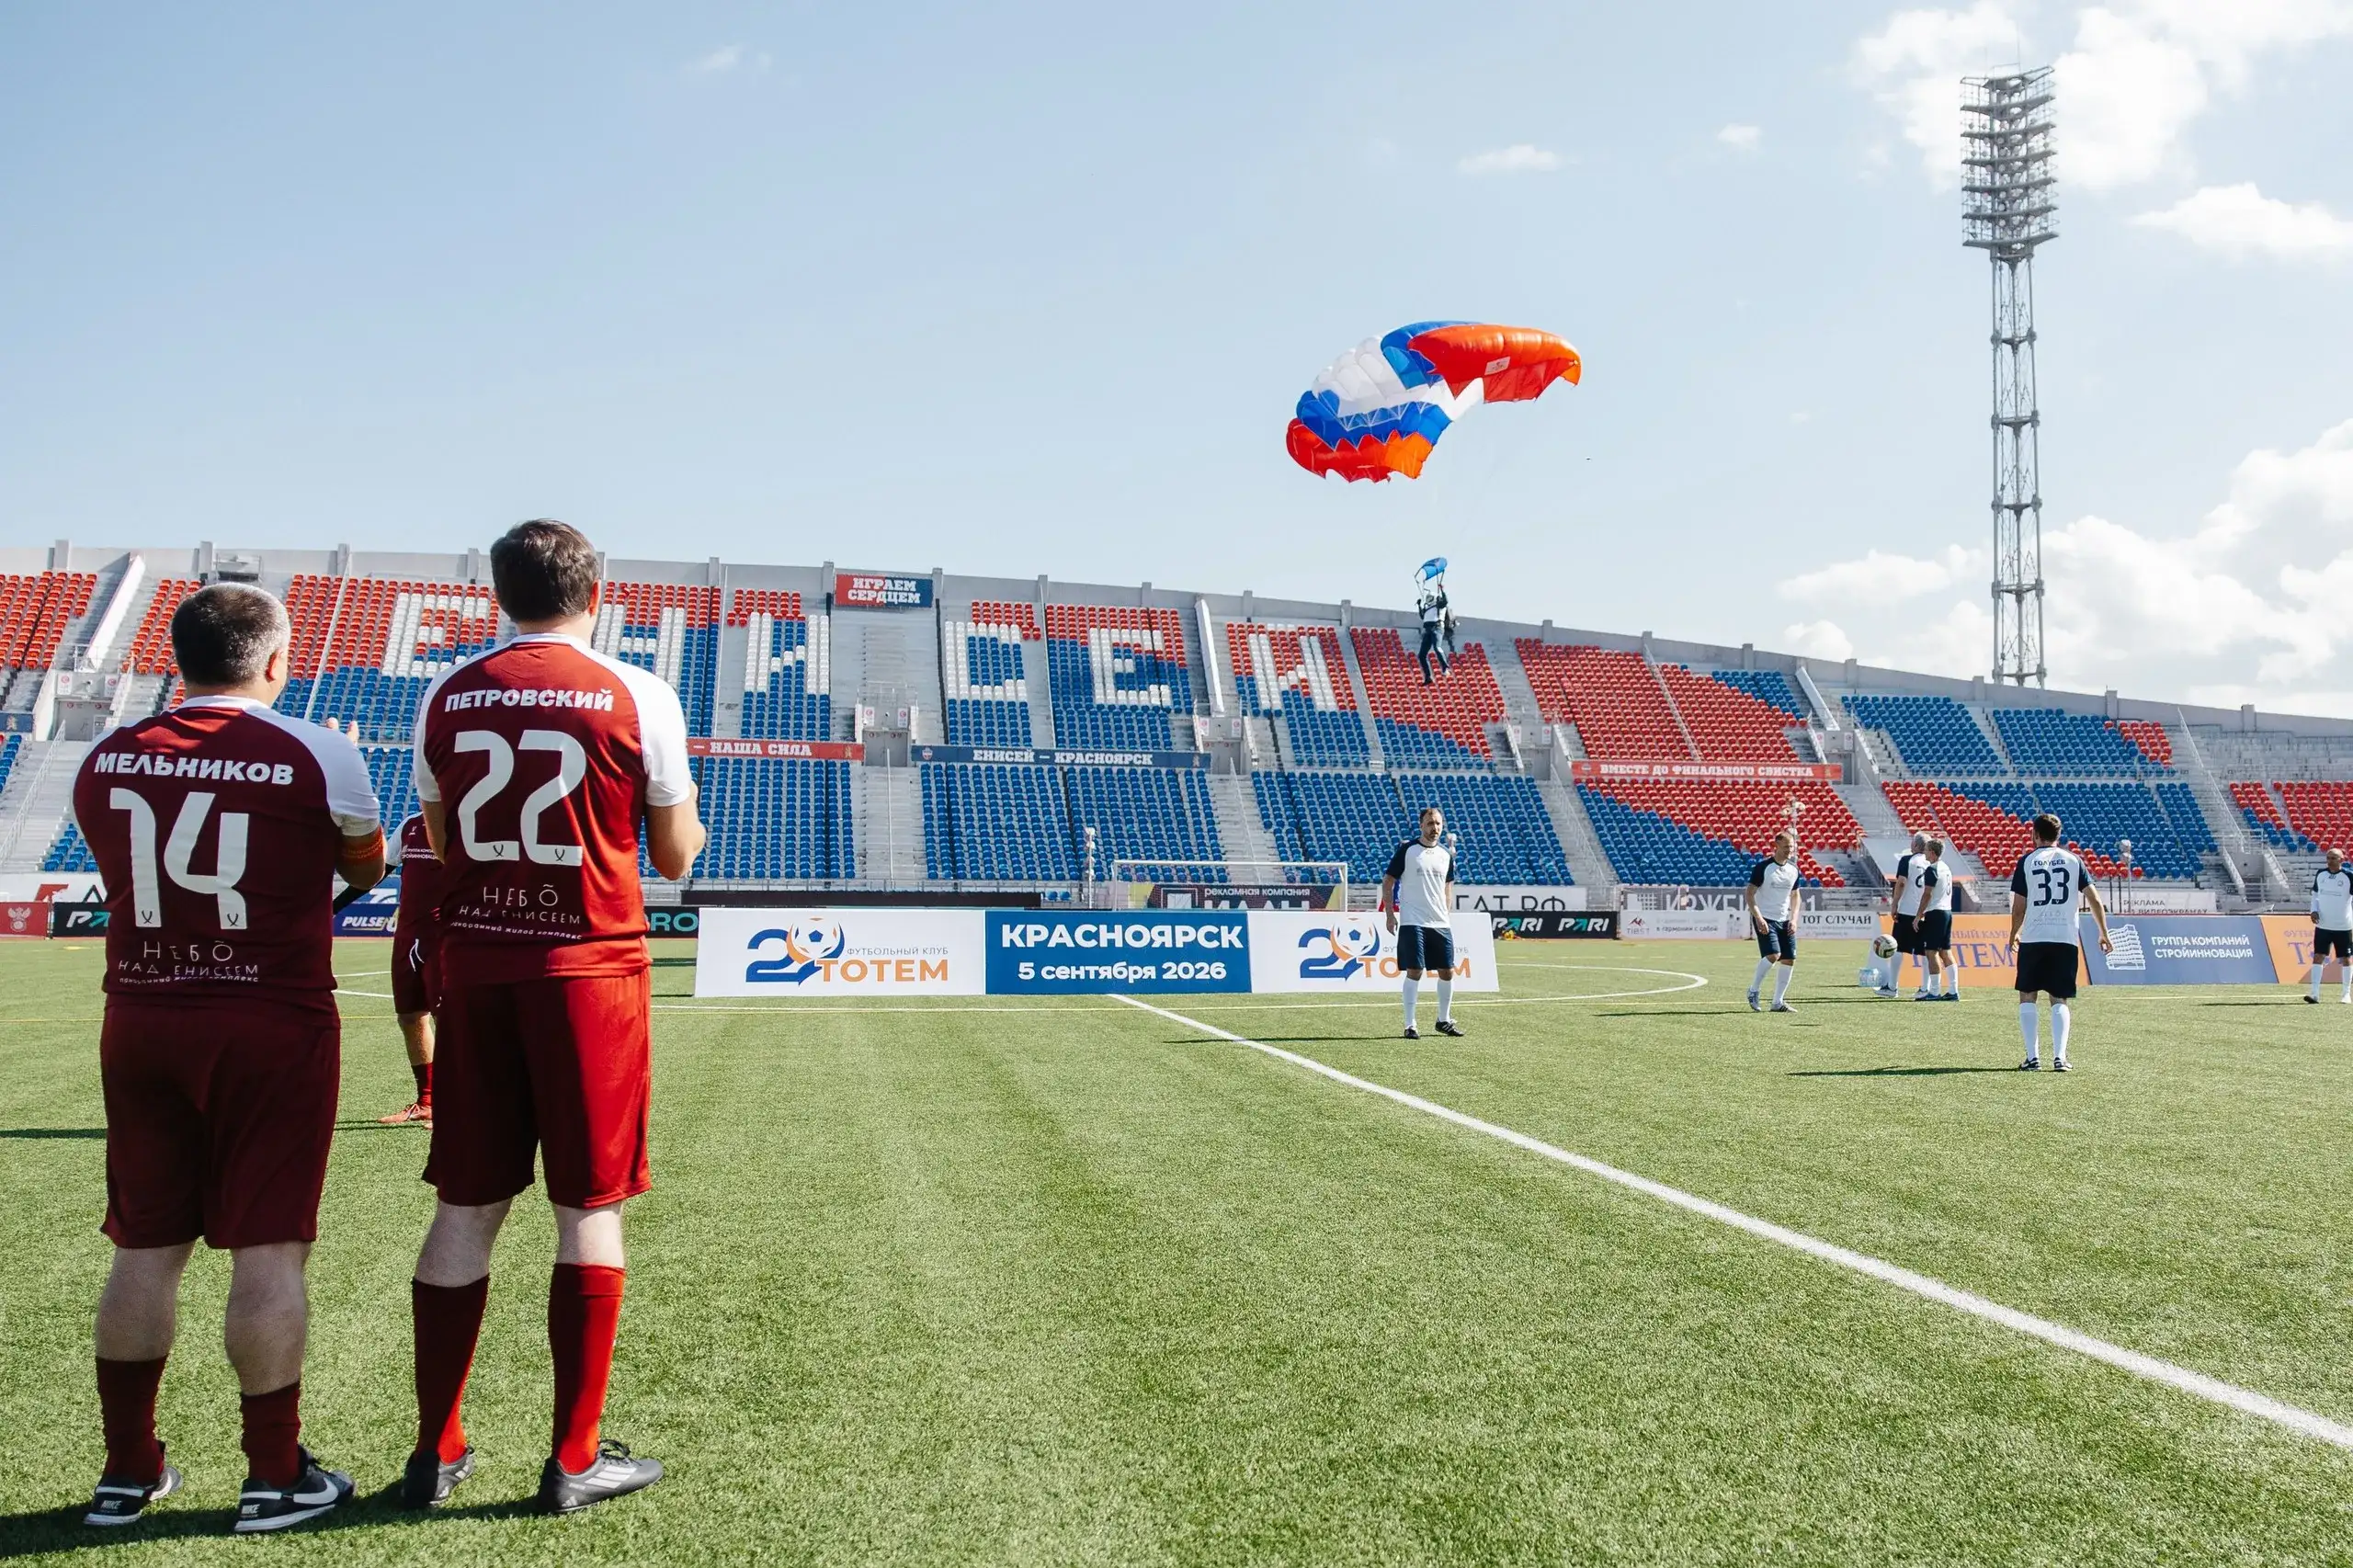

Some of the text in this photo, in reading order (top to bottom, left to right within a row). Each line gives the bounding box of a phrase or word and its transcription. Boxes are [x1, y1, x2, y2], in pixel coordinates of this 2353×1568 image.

[853, 578, 916, 591] ИГРАЕМ
[847, 589, 921, 604] СЕРДЦЕМ
[445, 688, 614, 712] ПЕТРОВСКИЙ
[710, 742, 763, 755] НАША
[767, 743, 813, 756] СИЛА
[972, 749, 1035, 763] ЕНИСЕЙ
[1054, 753, 1154, 765] КРАСНОЯРСК
[94, 752, 294, 786] МЕЛЬНИКОВ
[1599, 764, 1814, 777] ВМЕСТЕ ДО ФИНАЛЬНОГО СВИСТКА
[454, 729, 586, 867] 22
[109, 787, 250, 930] 14
[1204, 888, 1310, 898] рекламная компания
[2032, 867, 2070, 907] 33
[647, 913, 699, 932] RO
[1558, 917, 1609, 932] PARI
[1825, 914, 1871, 925] СЛУЧАЙ
[1001, 924, 1244, 949] КРАСНОЯРСК
[2151, 934, 2250, 946] ГРУППА КОМПАНИЙ
[847, 945, 949, 956] ФУТБОЛЬНЫЙ КЛУБ
[2154, 947, 2254, 959] СТРОЙИННОВАЦИЯ
[119, 960, 159, 973] НАД
[814, 959, 948, 983] ТОТЕМ
[1017, 961, 1227, 983] 5 сентября 2026
[1358, 957, 1472, 979] ТОМ
[100, 1500, 122, 1509] NIKE
[241, 1504, 260, 1515] NIKE
